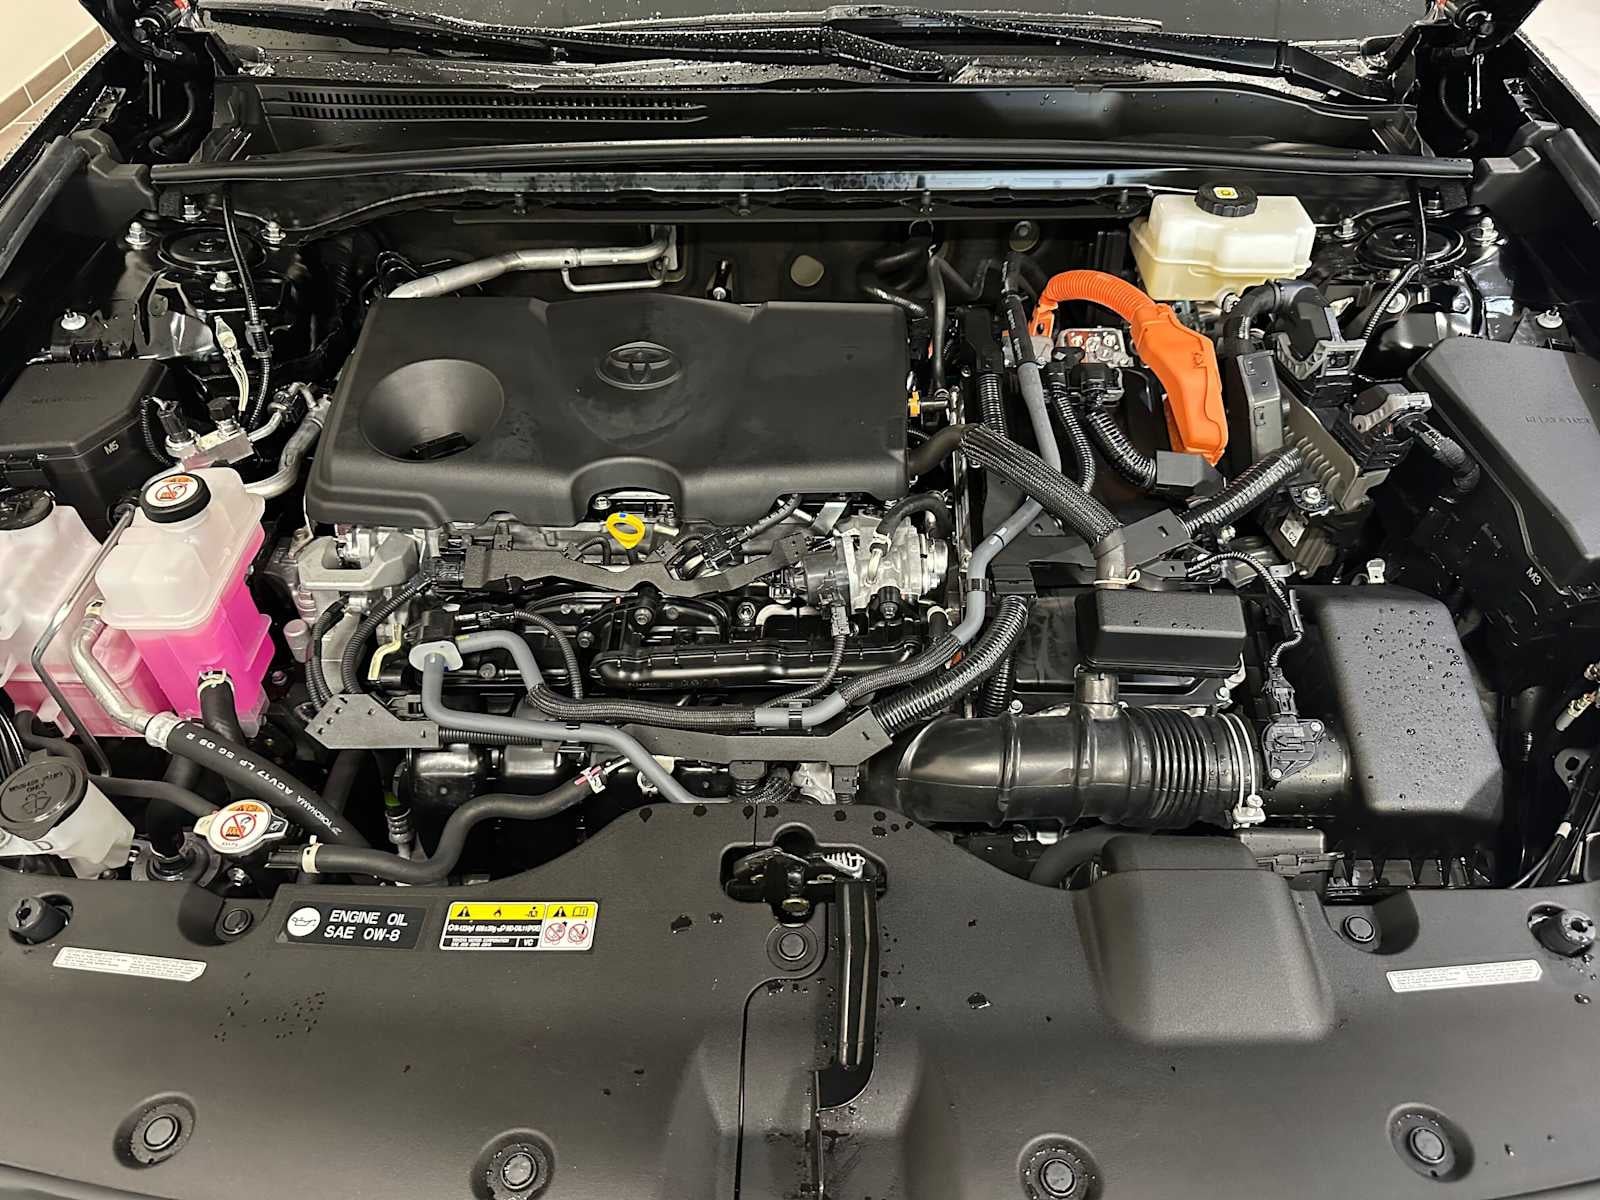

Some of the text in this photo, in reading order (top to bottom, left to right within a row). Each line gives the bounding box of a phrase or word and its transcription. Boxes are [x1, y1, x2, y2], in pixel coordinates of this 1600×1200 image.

[104, 440, 119, 455] M5
[1288, 531, 1297, 542] C2
[1526, 567, 1542, 585] M3
[239, 759, 256, 771] LP
[257, 770, 294, 795] ACV17
[296, 795, 333, 830] YOKOHAMA
[329, 909, 408, 927] ENGINE OIL
[324, 925, 401, 942] SAE 0W-8
[523, 938, 534, 947] VC
